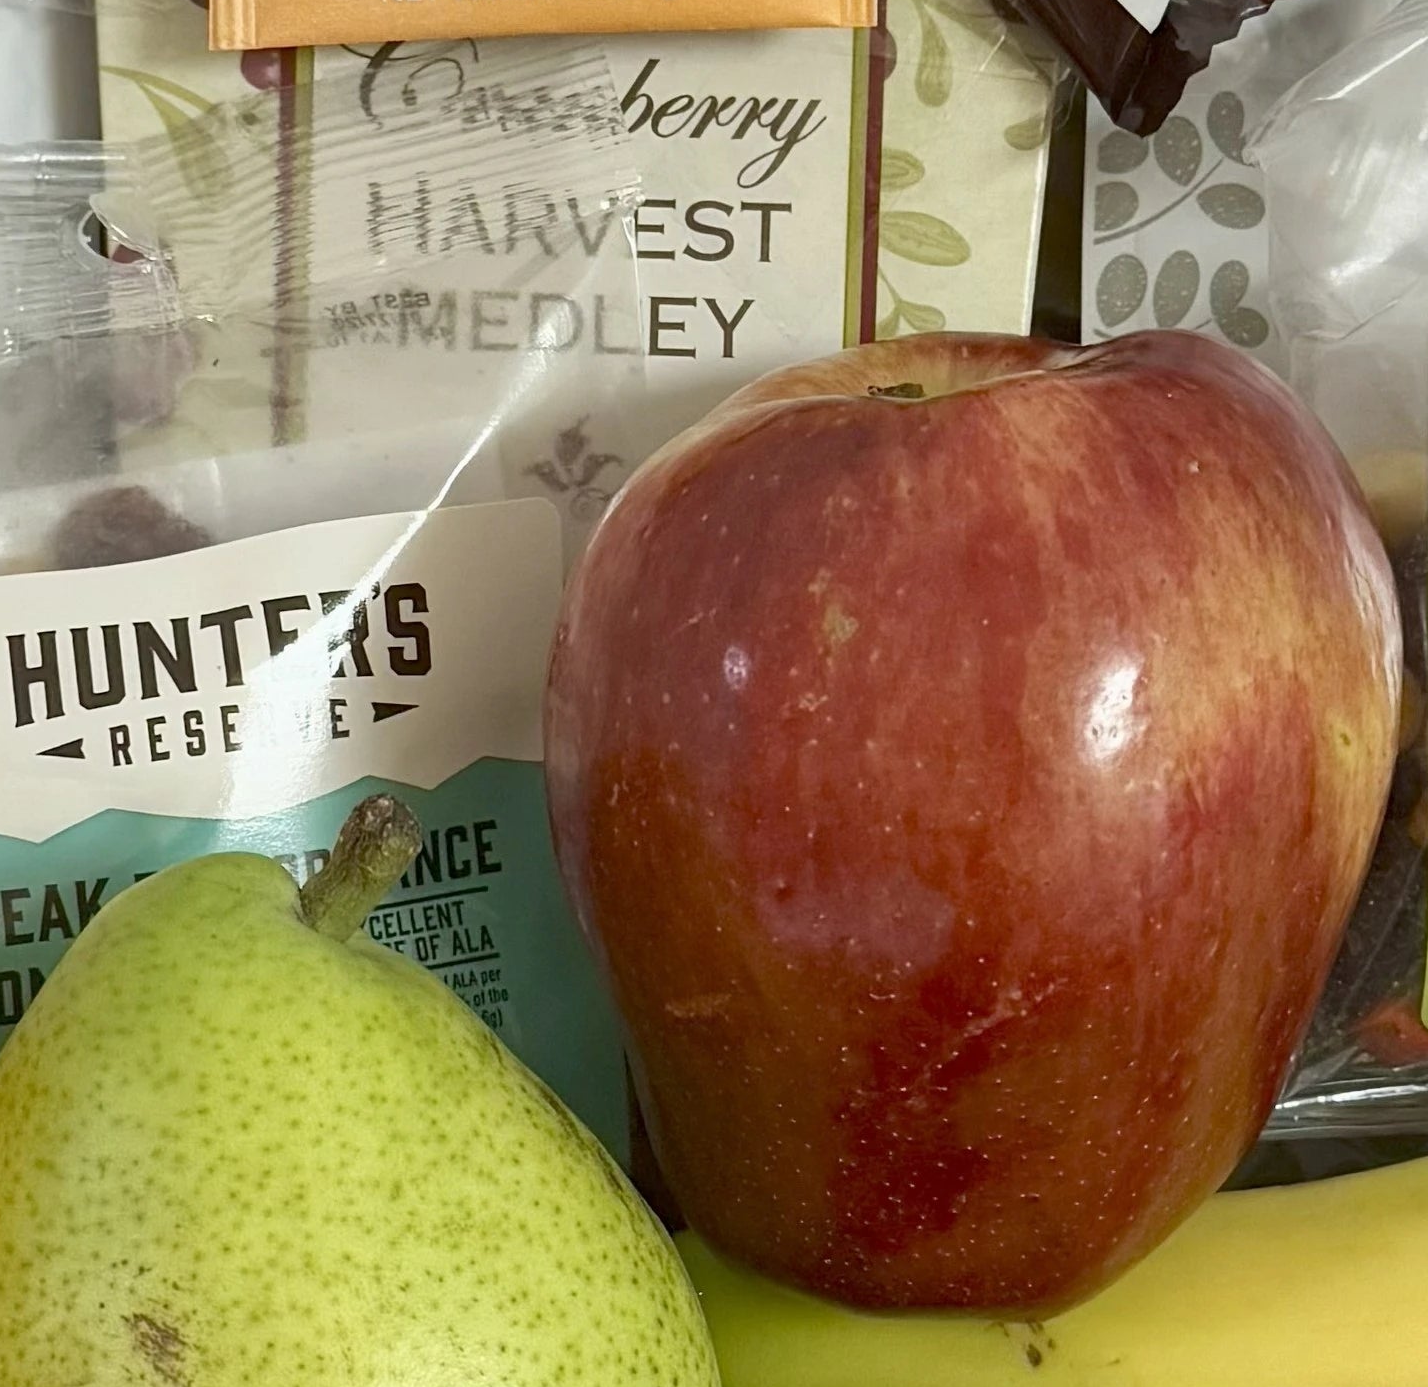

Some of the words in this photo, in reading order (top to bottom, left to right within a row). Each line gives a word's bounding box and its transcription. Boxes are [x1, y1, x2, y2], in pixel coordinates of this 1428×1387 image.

[367, 172, 793, 263] HARVEST
[393, 290, 756, 359] MEDLEY
[362, 899, 465, 941] CELLENT
[452, 924, 495, 957] ALA
